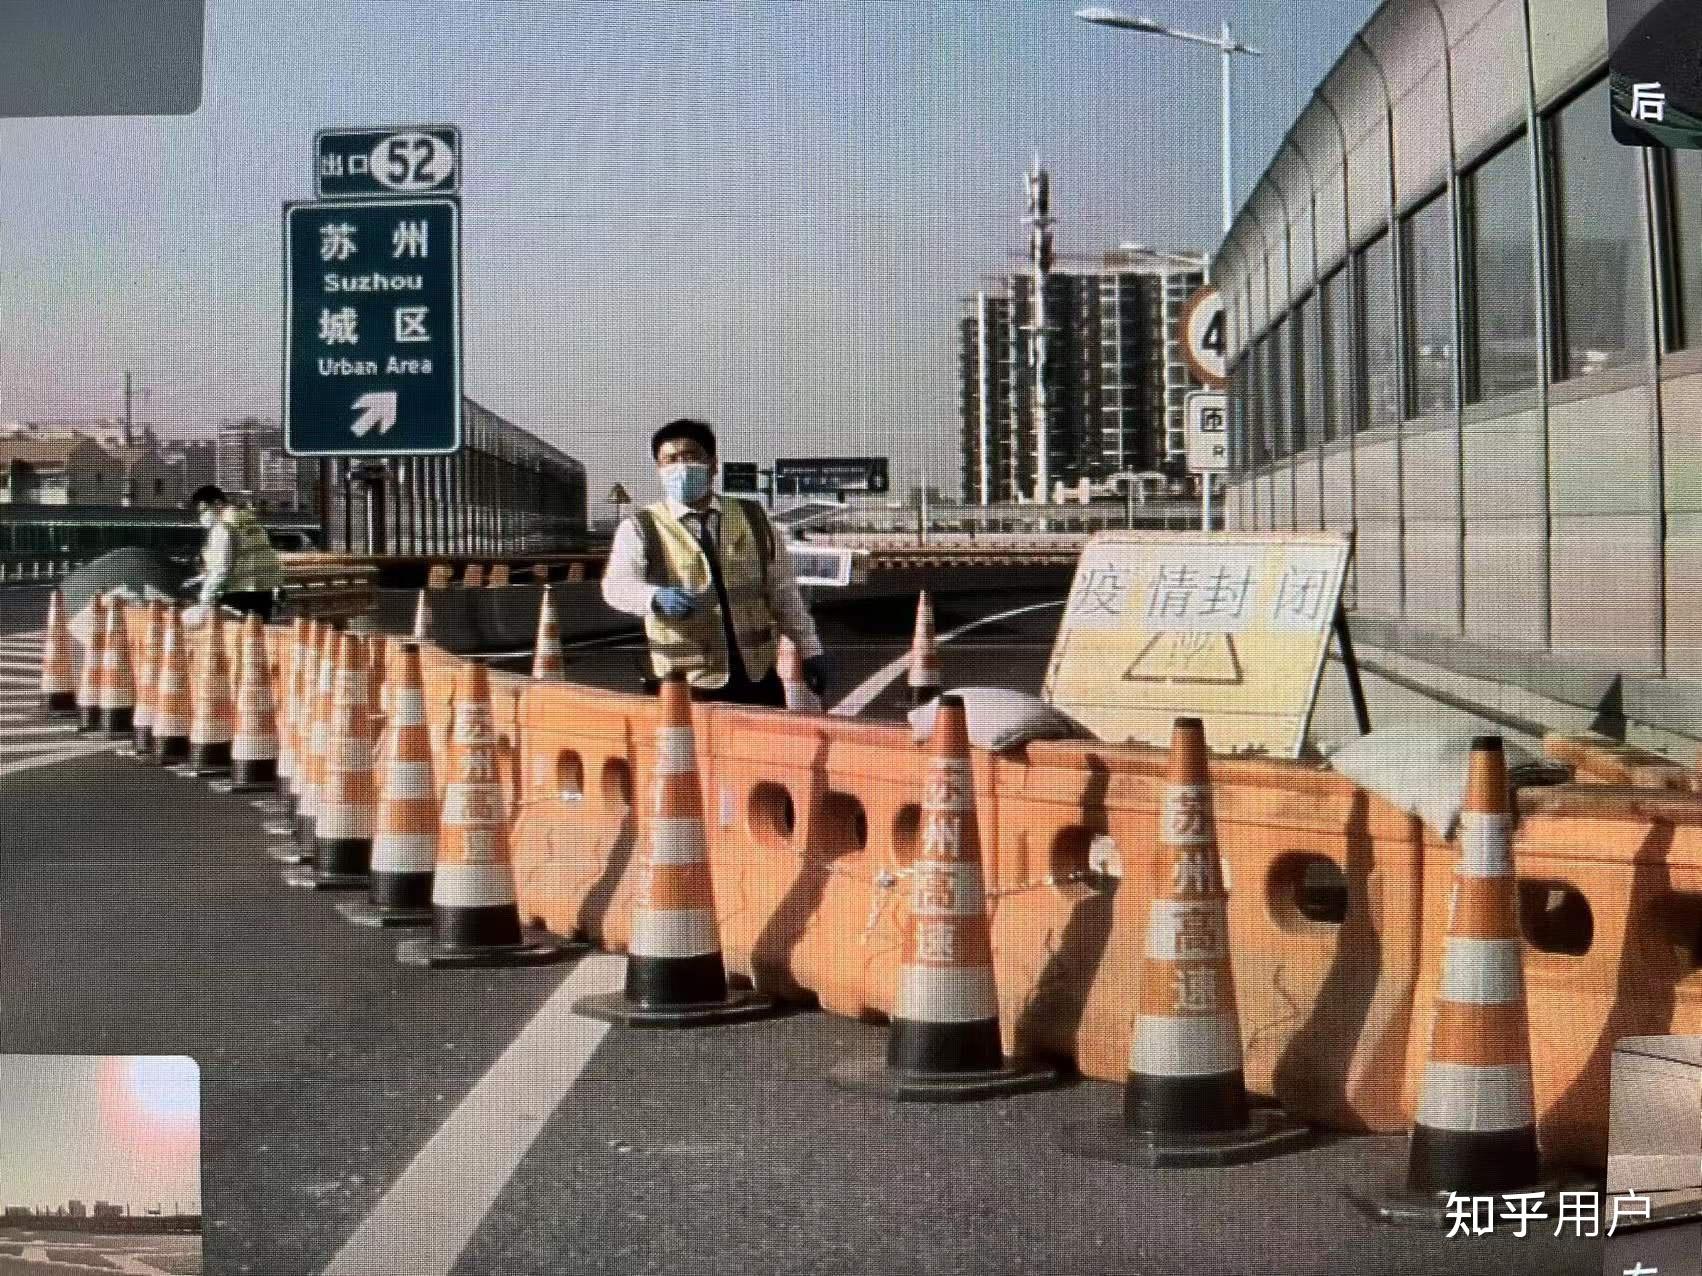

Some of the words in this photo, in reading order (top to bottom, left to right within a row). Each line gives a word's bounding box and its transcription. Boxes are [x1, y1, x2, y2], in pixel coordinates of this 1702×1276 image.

[1631, 82, 1665, 121] 后
[320, 153, 369, 176] 出口
[387, 139, 436, 184] 52
[320, 221, 429, 260] 苏州
[323, 272, 424, 292] Suzhou
[319, 306, 432, 344] 城区
[1201, 308, 1228, 356] 4
[317, 358, 378, 376] Urban
[385, 355, 433, 375] Area
[1201, 408, 1228, 432] 匝
[1070, 563, 1328, 619] 疫情封闭
[1172, 793, 1217, 1010] 苏州高速
